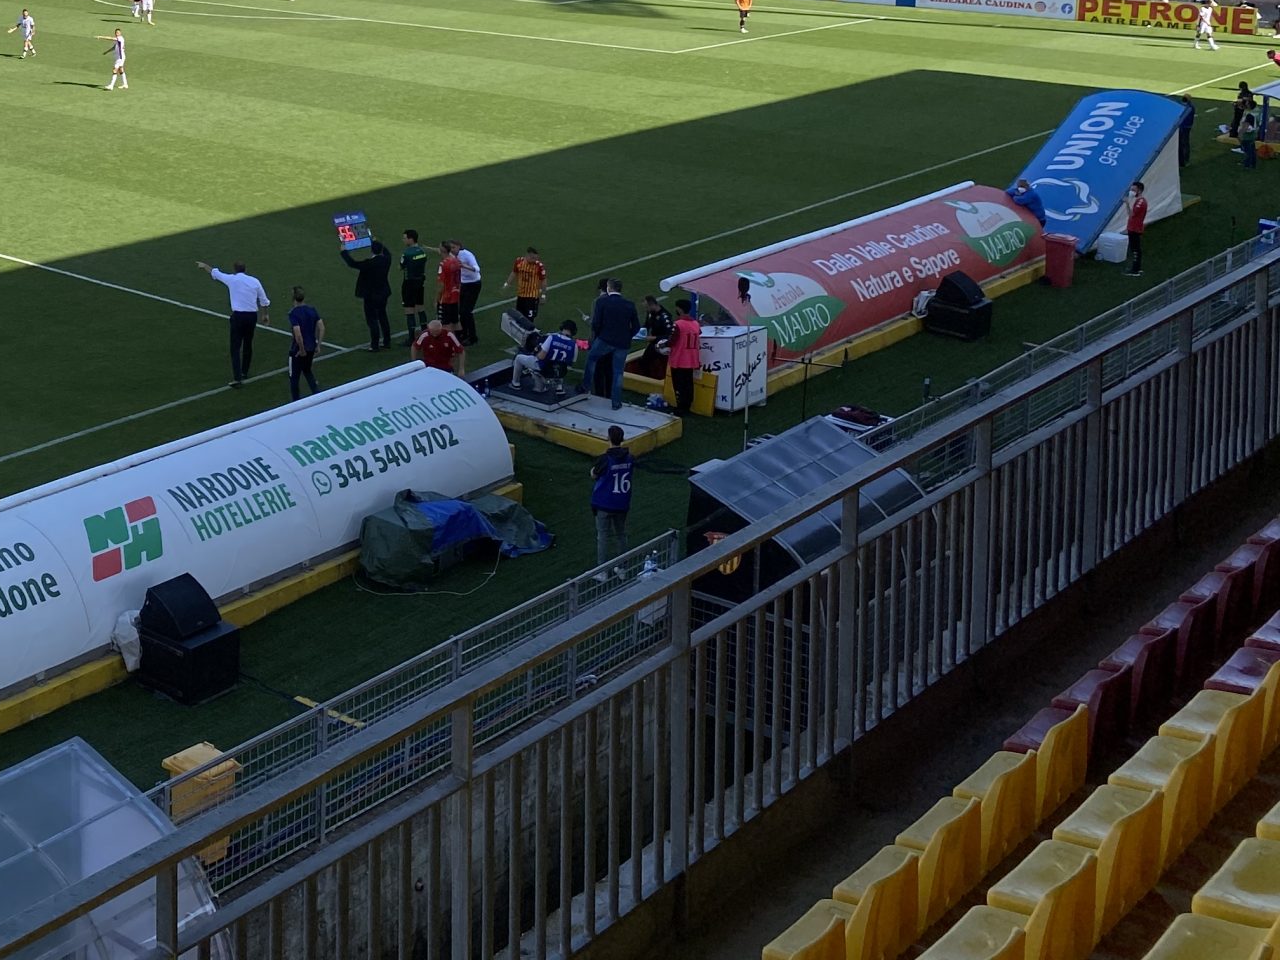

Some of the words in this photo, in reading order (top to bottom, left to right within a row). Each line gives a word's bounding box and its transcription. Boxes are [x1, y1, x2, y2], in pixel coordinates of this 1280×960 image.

[985, 0, 1033, 10] CAUDINA
[1090, 15, 1228, 33] ARREDAMETI
[1046, 101, 1129, 172] UNION
[1099, 144, 1122, 167] gas
[1113, 133, 1129, 146] e
[1124, 115, 1145, 139] luce
[812, 252, 863, 276] Dalla
[849, 240, 896, 262] Valle
[886, 222, 951, 249] Caudina
[979, 227, 1026, 264] MAURO
[850, 269, 904, 302] Natura
[902, 266, 915, 283] e
[910, 248, 961, 279] Sapore
[771, 303, 831, 348] MAURO
[285, 385, 477, 467] nardoneforni.com
[329, 454, 375, 489] 342
[375, 439, 412, 474] 540
[413, 423, 459, 462] 4702
[612, 471, 631, 494] 16
[167, 455, 280, 512] NARDONE
[190, 482, 297, 542] HOTELLERIE
